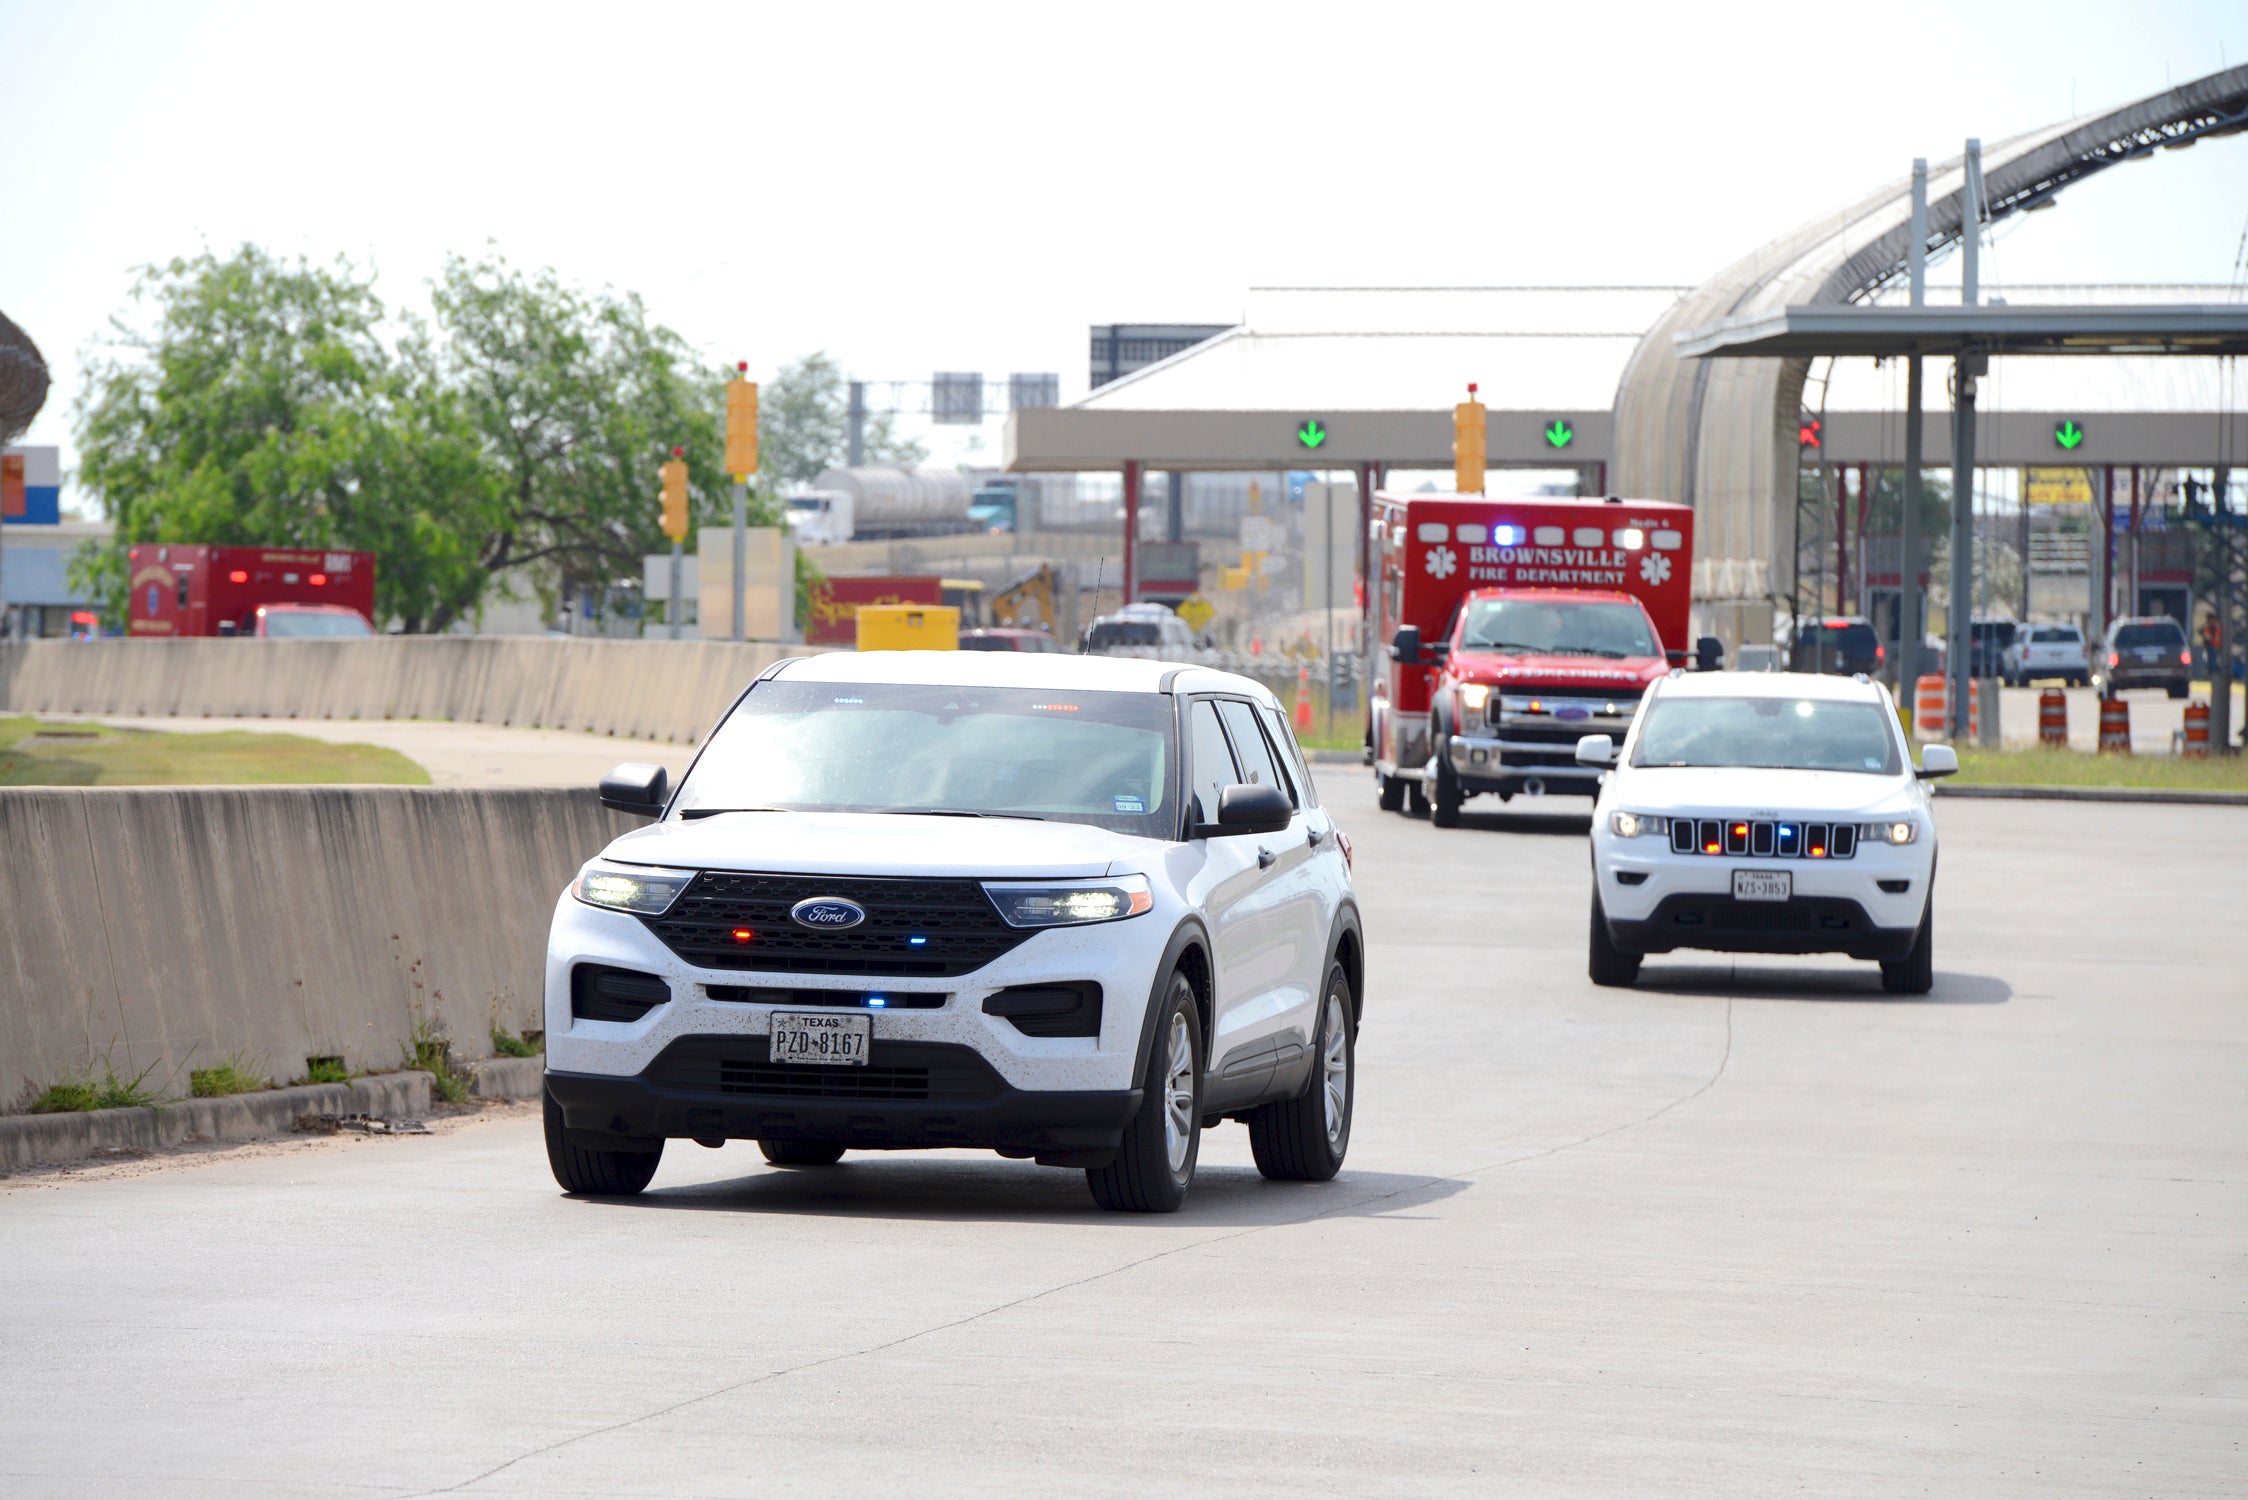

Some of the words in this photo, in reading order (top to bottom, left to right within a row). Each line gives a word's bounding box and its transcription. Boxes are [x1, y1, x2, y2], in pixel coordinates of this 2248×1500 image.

[1469, 546, 1627, 567] BROWNSVILLE
[1469, 567, 1507, 580] FIRE
[1516, 568, 1626, 584] DEPARTMENT
[808, 905, 848, 923] Ford
[803, 1017, 840, 1028] TEXAS
